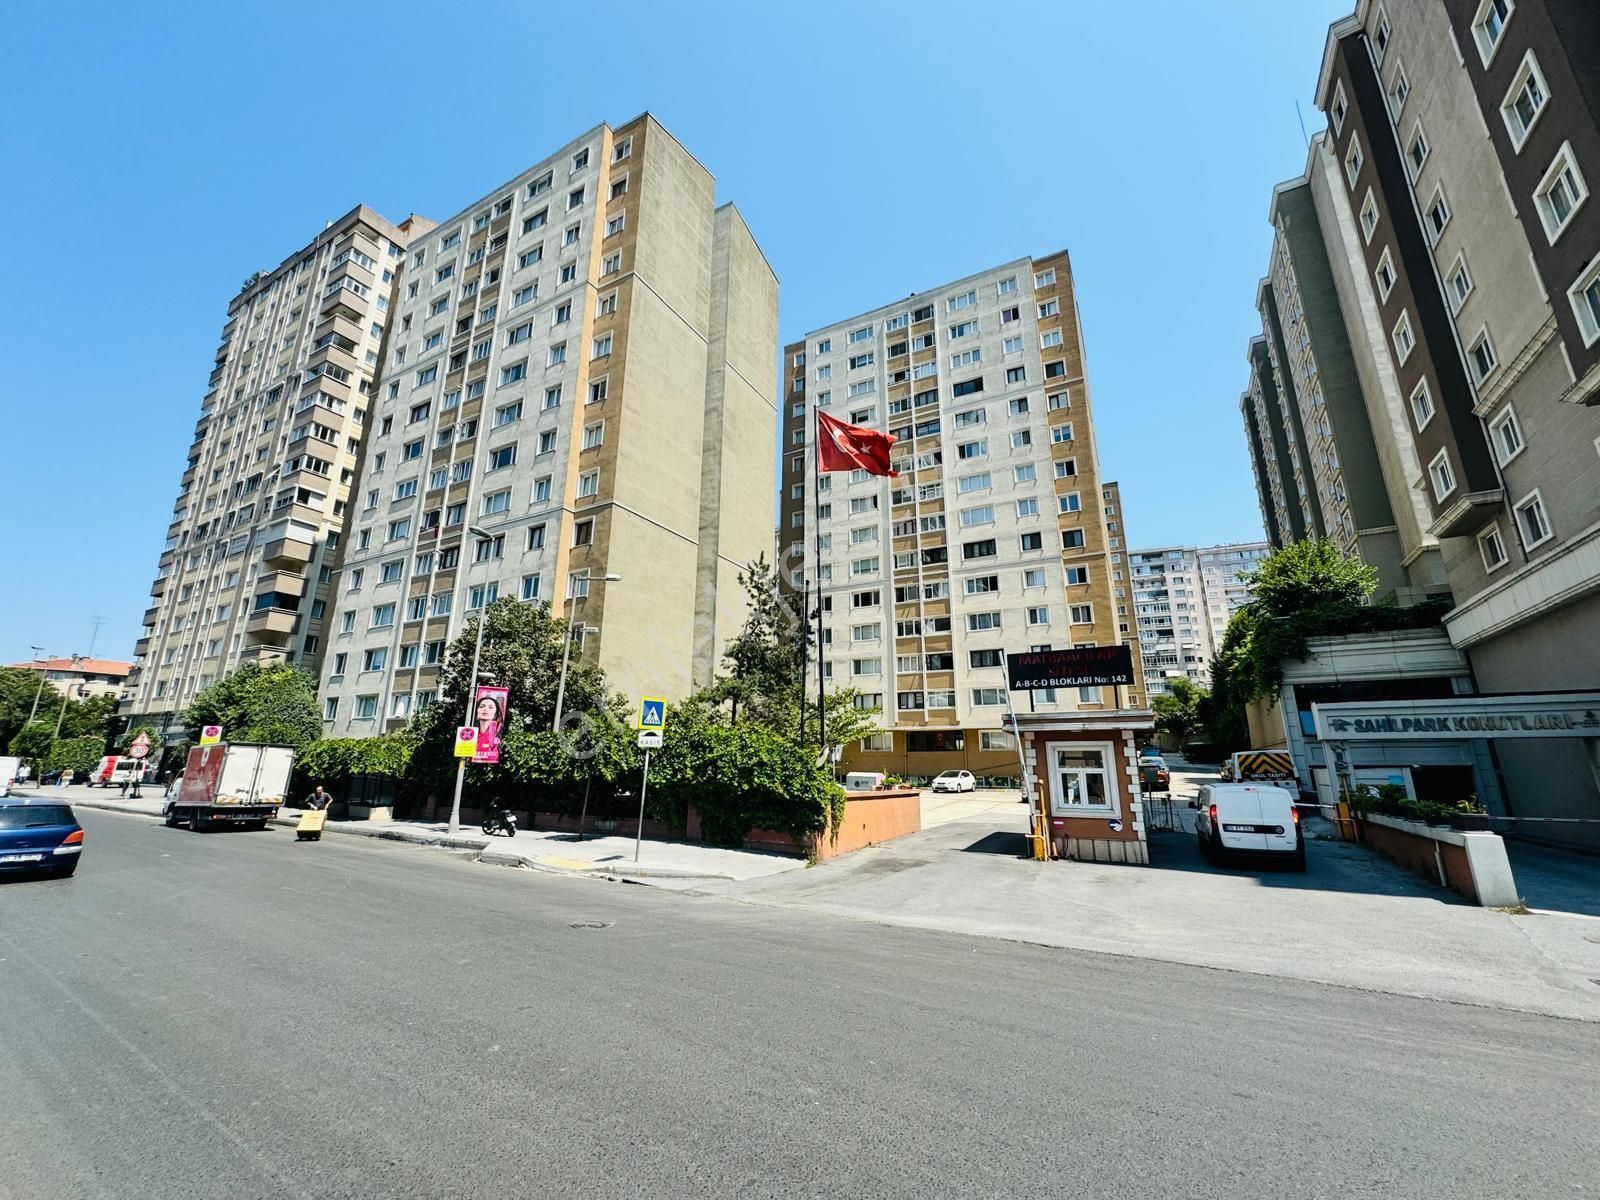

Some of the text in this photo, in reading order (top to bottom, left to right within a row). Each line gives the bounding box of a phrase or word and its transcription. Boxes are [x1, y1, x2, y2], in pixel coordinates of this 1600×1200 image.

[1015, 674, 1127, 688] A-B-C-D BLOKLARI No: 142
[1455, 714, 1574, 732] KONUTLARI
[134, 747, 145, 755] 30
